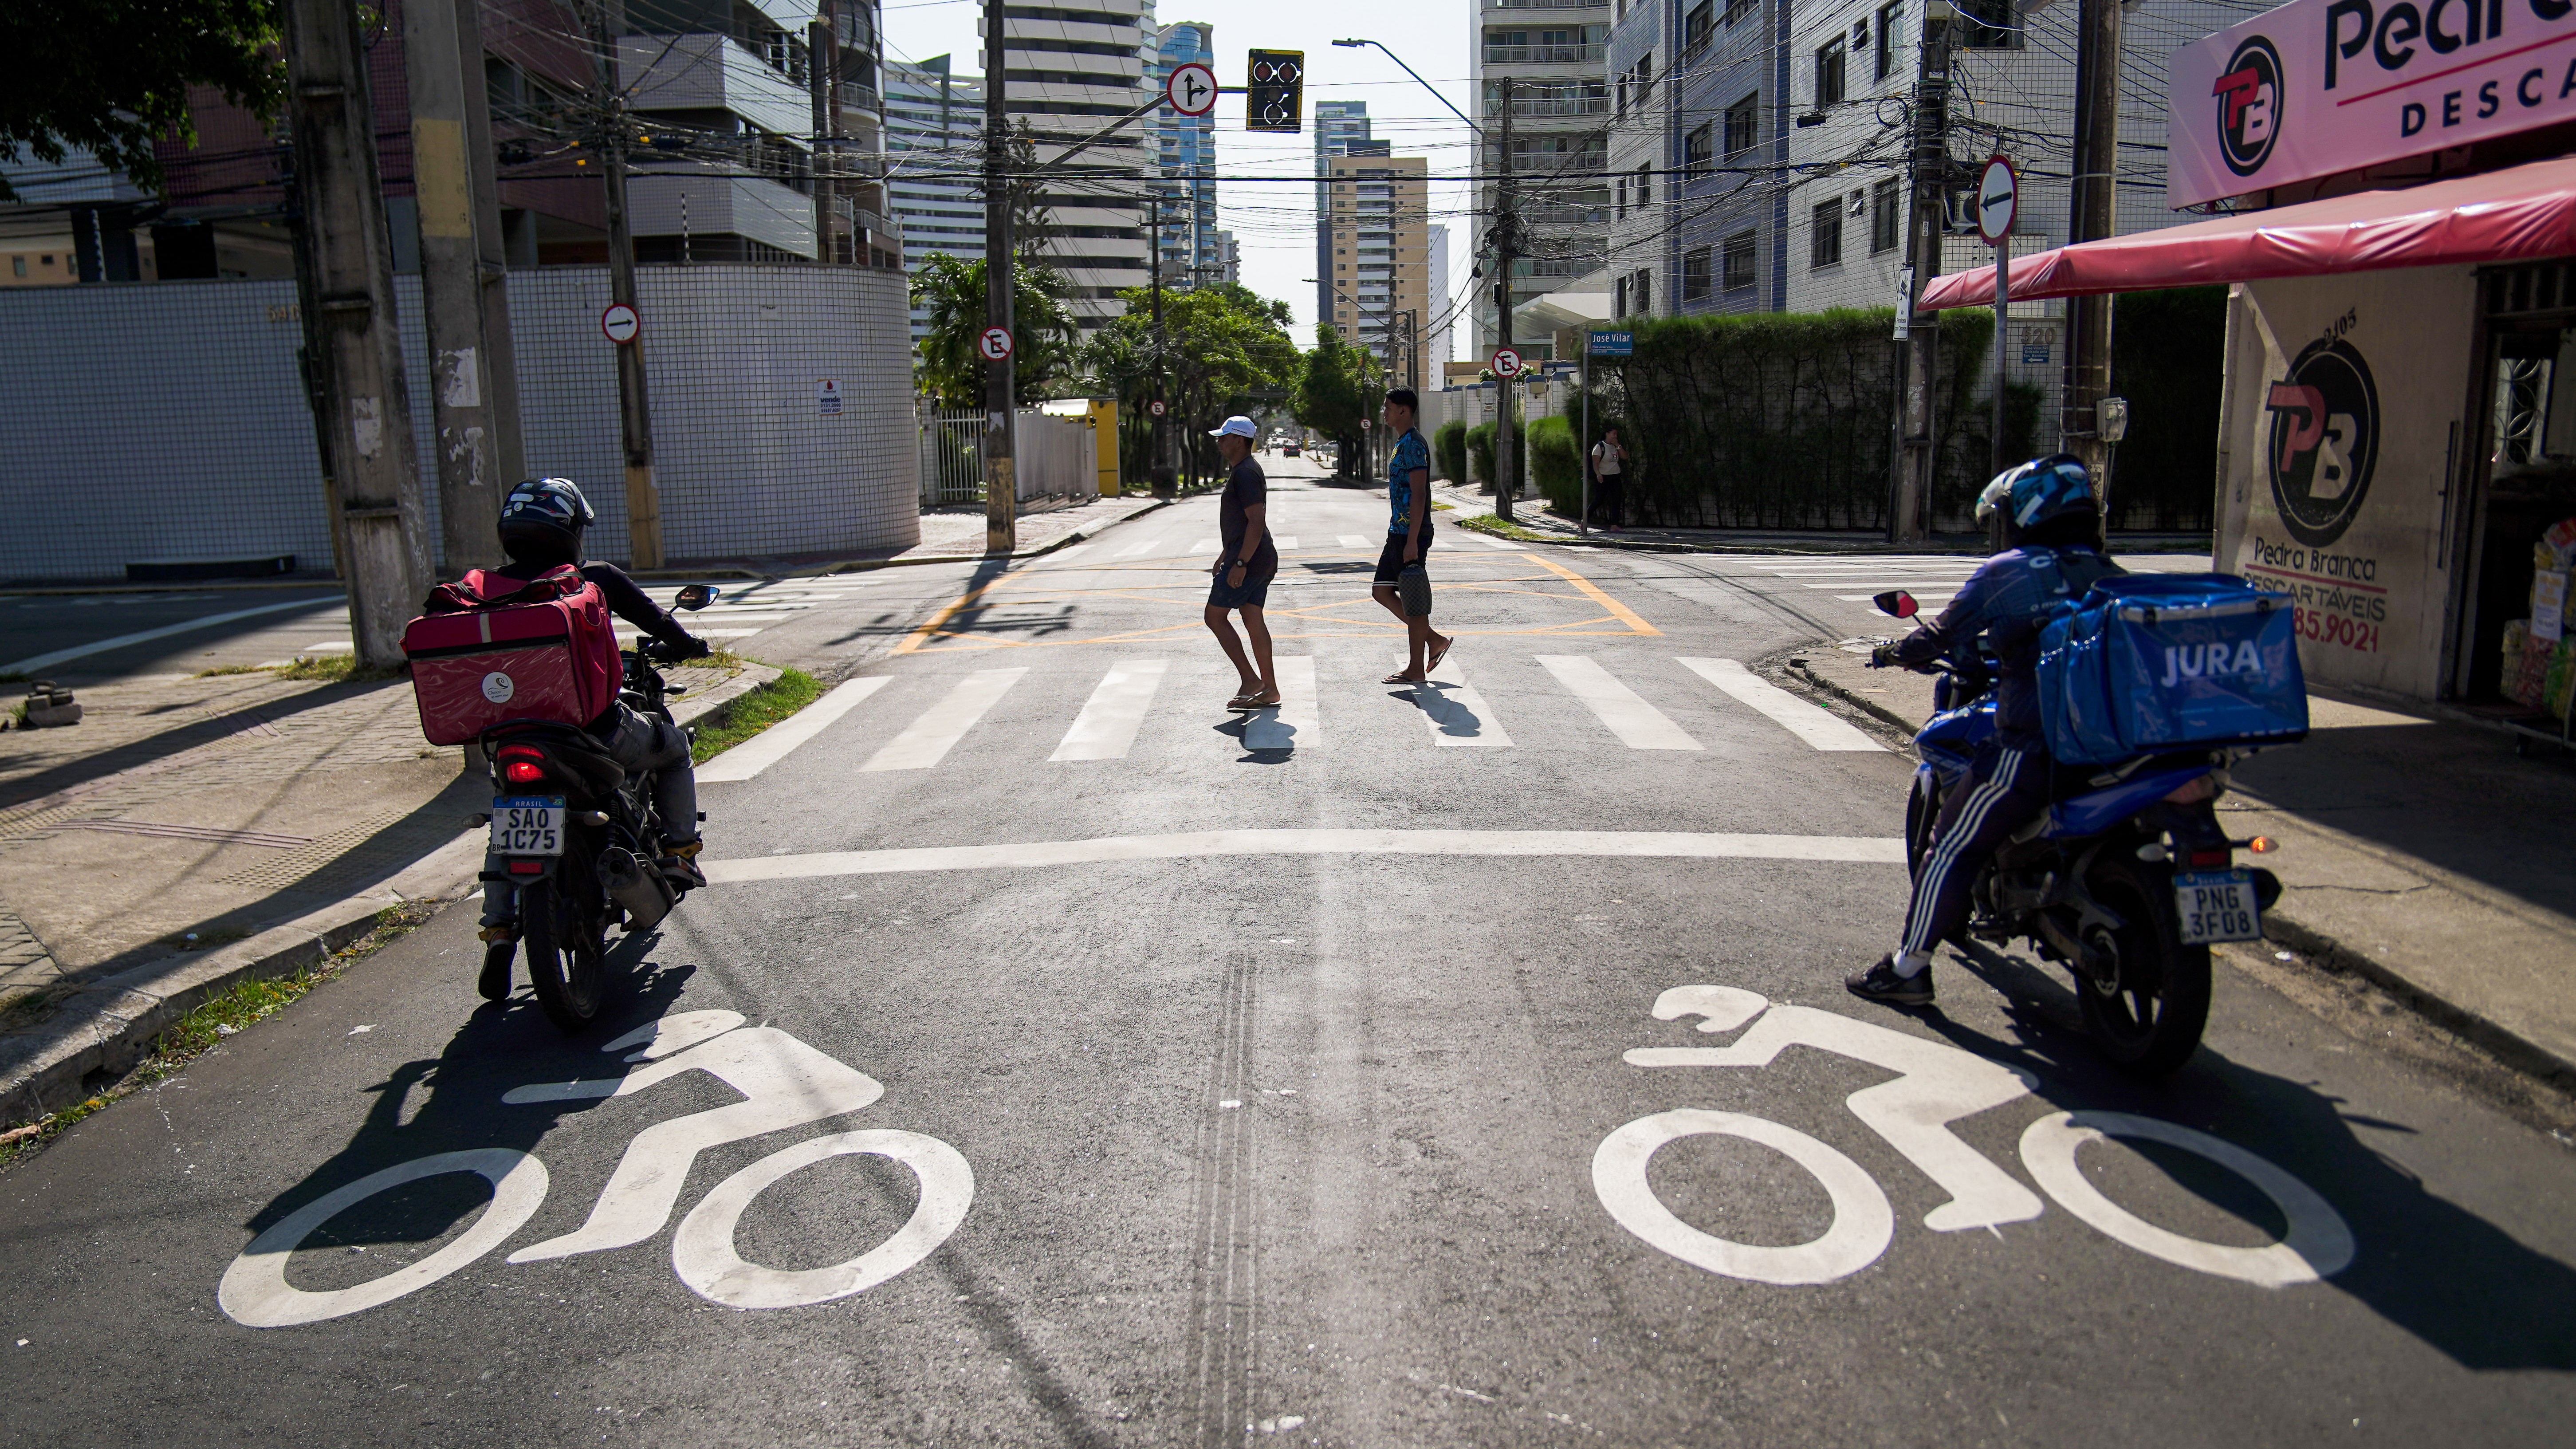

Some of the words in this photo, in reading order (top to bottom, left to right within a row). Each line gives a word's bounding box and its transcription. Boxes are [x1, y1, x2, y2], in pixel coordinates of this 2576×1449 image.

[1593, 334, 1609, 343] José
[1612, 333, 1630, 342] Vilar
[2021, 327, 2056, 345] 520
[2254, 536, 2304, 569] Pedra
[2310, 549, 2376, 581] Branca
[2160, 639, 2262, 688] JURA
[500, 830, 555, 850] 1C75
[2195, 886, 2240, 911] PNG
[2190, 910, 2250, 936] 3F08
